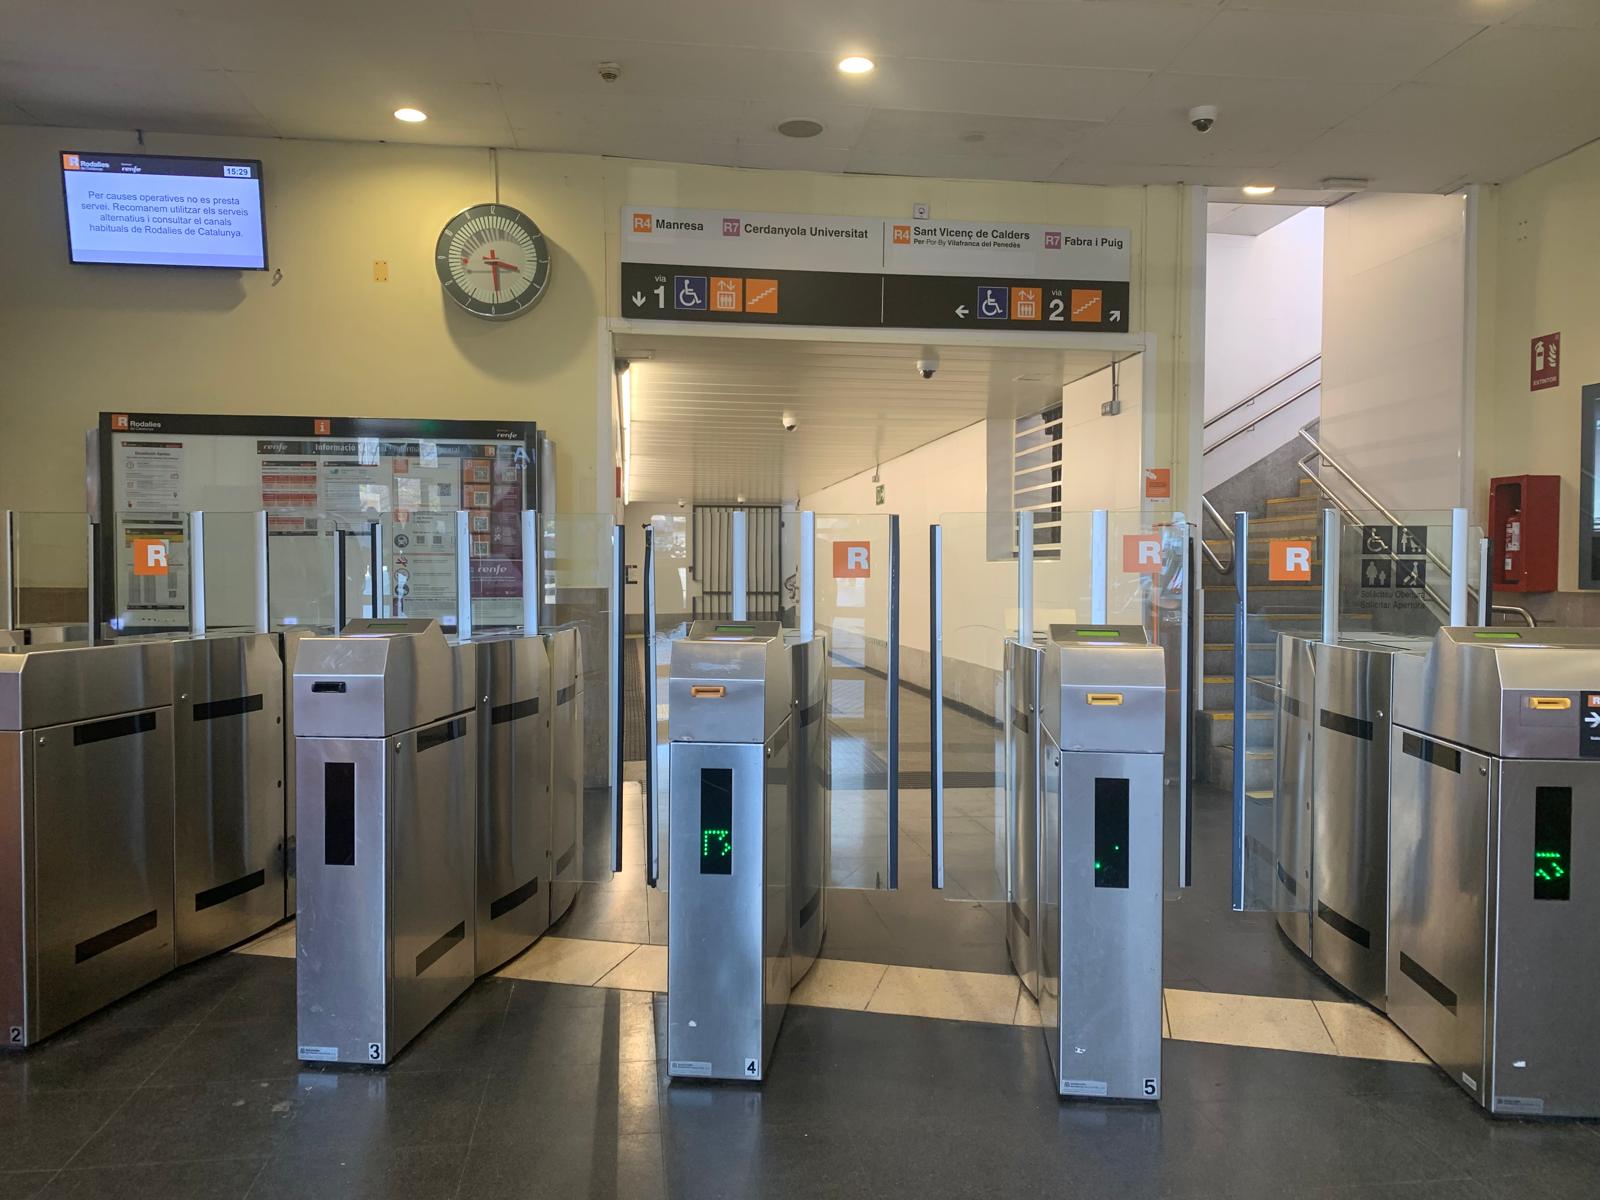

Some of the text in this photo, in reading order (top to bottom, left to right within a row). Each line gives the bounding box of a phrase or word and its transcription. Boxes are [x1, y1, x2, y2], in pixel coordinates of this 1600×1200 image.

[226, 167, 249, 176] 15:29
[88, 190, 104, 199] Per
[106, 193, 137, 201] causes
[139, 193, 185, 203] operatives
[213, 197, 240, 205] presta
[81, 202, 249, 217] servei. Recomanem utilitzar els serveis
[100, 213, 145, 222] alternatius
[152, 215, 192, 225] consultar
[194, 217, 202, 225] el
[204, 218, 232, 226] canals
[655, 218, 704, 231] Manresa
[89, 223, 129, 233] habituals
[131, 225, 142, 233] de
[144, 225, 183, 235] Rodalies
[184, 227, 196, 235] de
[724, 222, 869, 239] R7 Cerdanyola Universitat
[913, 226, 937, 236] Sant
[939, 227, 973, 240] Vicenç
[975, 228, 989, 238] de
[991, 229, 1030, 240] Calders
[1046, 235, 1061, 246] R7
[1064, 236, 1093, 246] Fabra
[1101, 237, 1123, 250] Puig
[654, 274, 667, 283] via
[653, 285, 665, 309] 1
[1051, 288, 1062, 297] via
[1048, 298, 1065, 321] 2
[118, 416, 161, 428] R Rodalies
[496, 431, 518, 440] renfe
[263, 442, 289, 453] renfe
[315, 442, 356, 452] Informació
[147, 544, 168, 567] R
[847, 546, 869, 570] R
[1138, 541, 1162, 564] R
[1286, 547, 1310, 572] R
[477, 564, 508, 575] renfe
[11, 1027, 21, 1042] 2
[369, 1043, 381, 1060] 3
[746, 1060, 757, 1074] 4
[1144, 1079, 1156, 1095] 5
